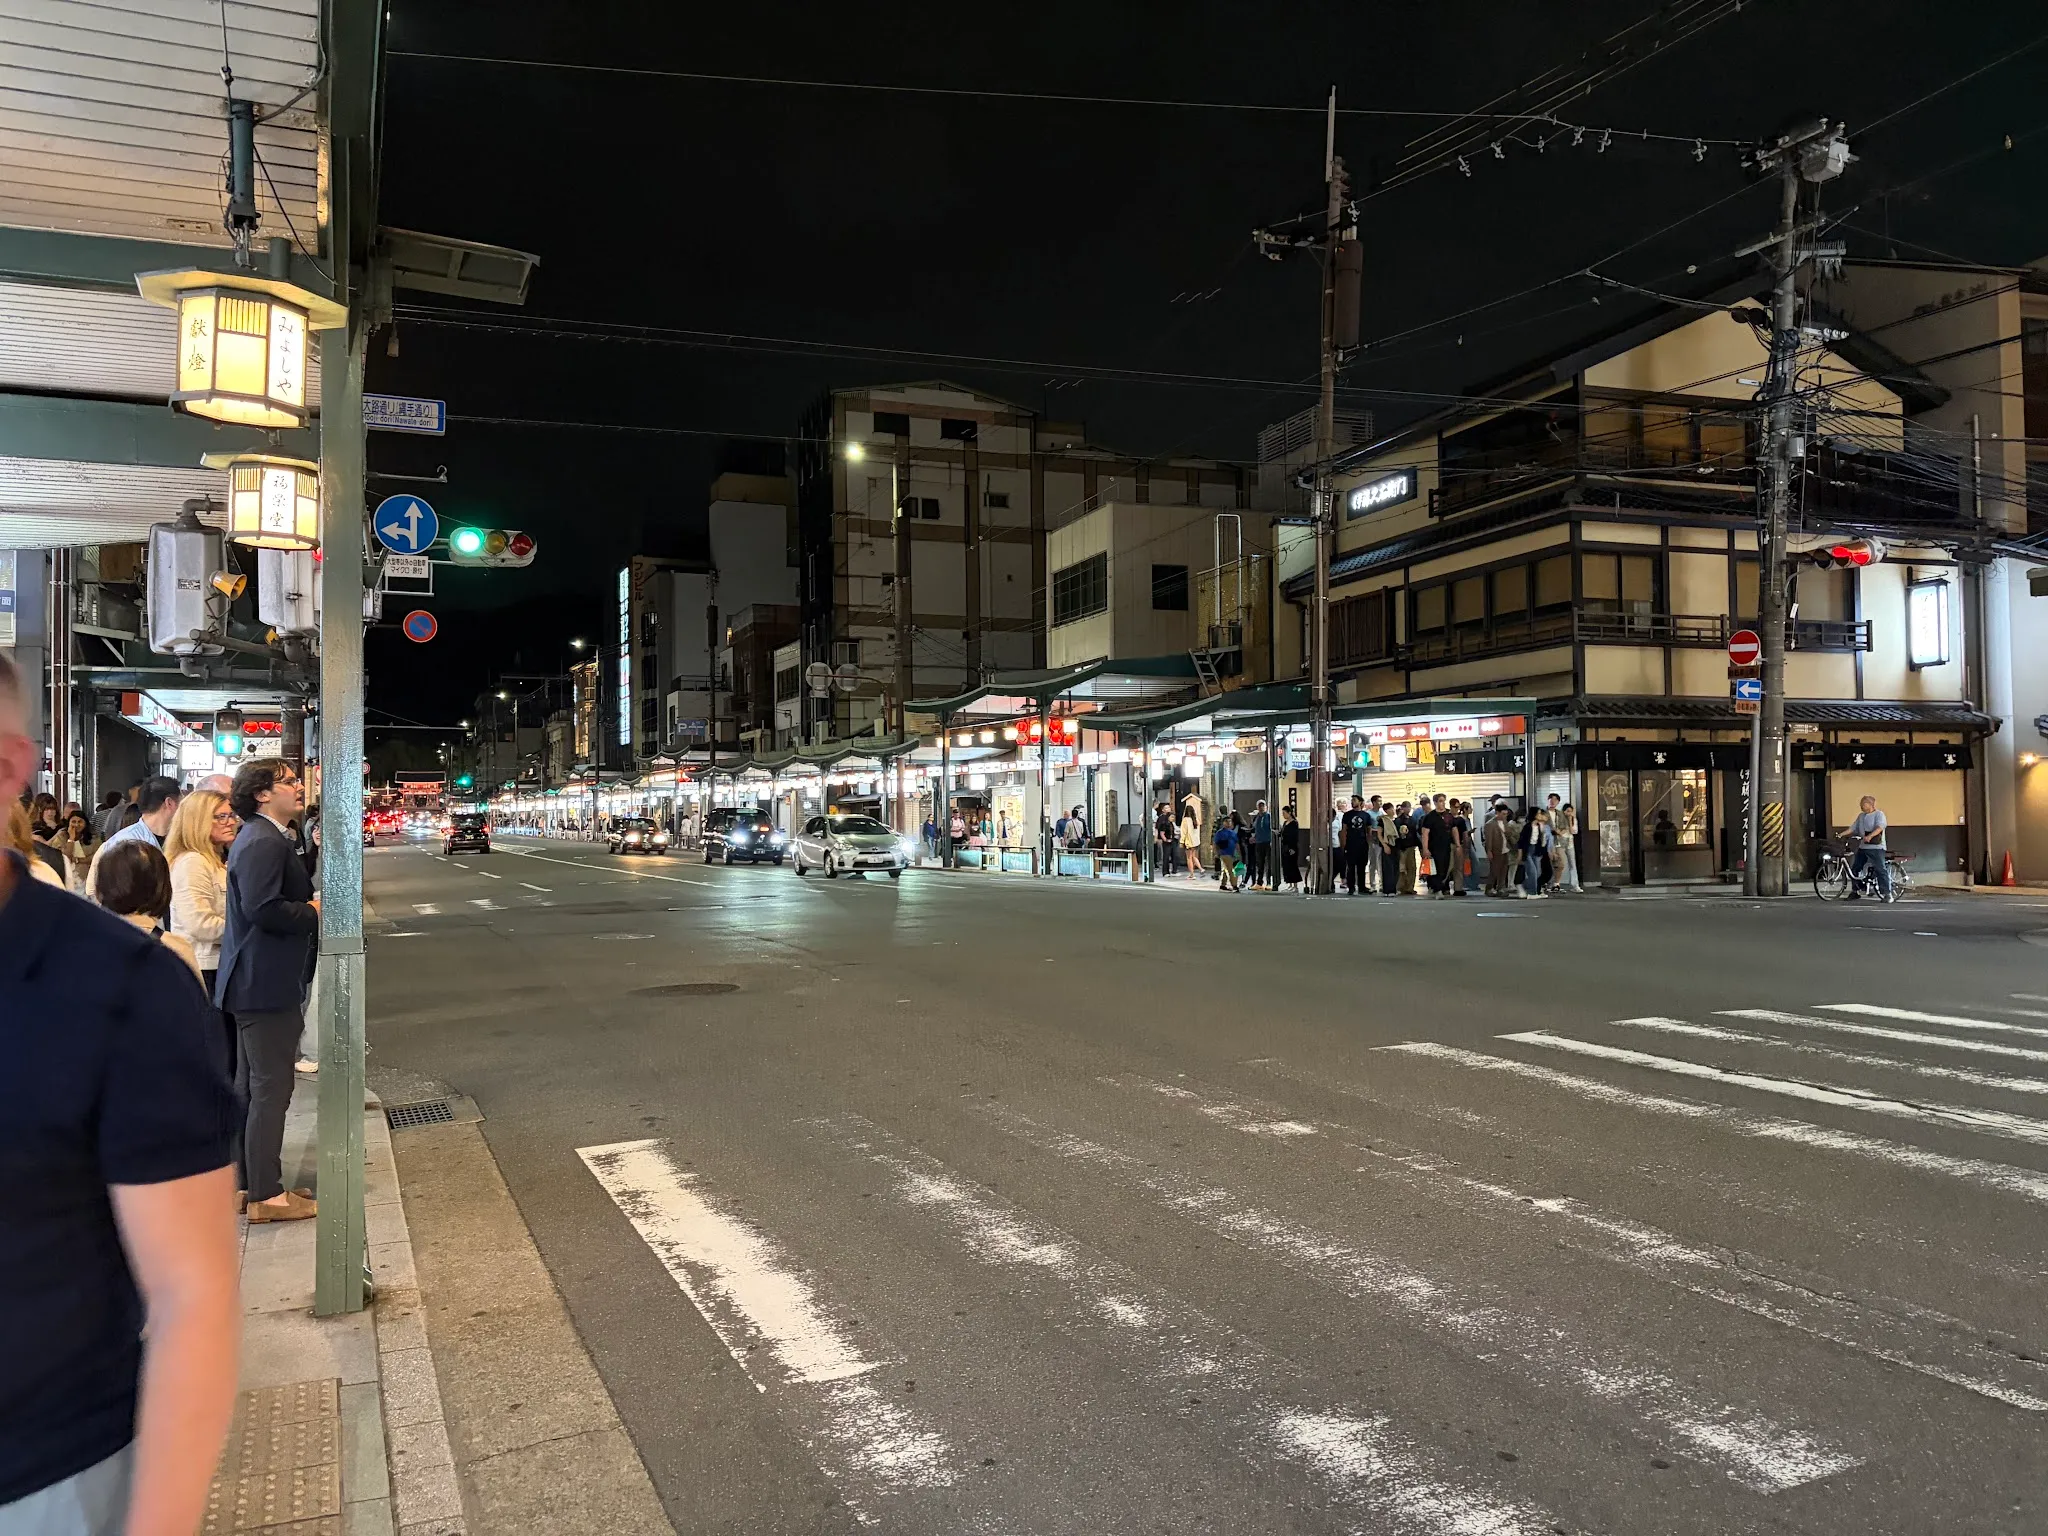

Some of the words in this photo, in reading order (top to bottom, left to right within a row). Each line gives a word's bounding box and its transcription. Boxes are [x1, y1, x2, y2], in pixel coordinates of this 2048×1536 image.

[276, 316, 294, 396] みよしや
[678, 723, 687, 733] P
